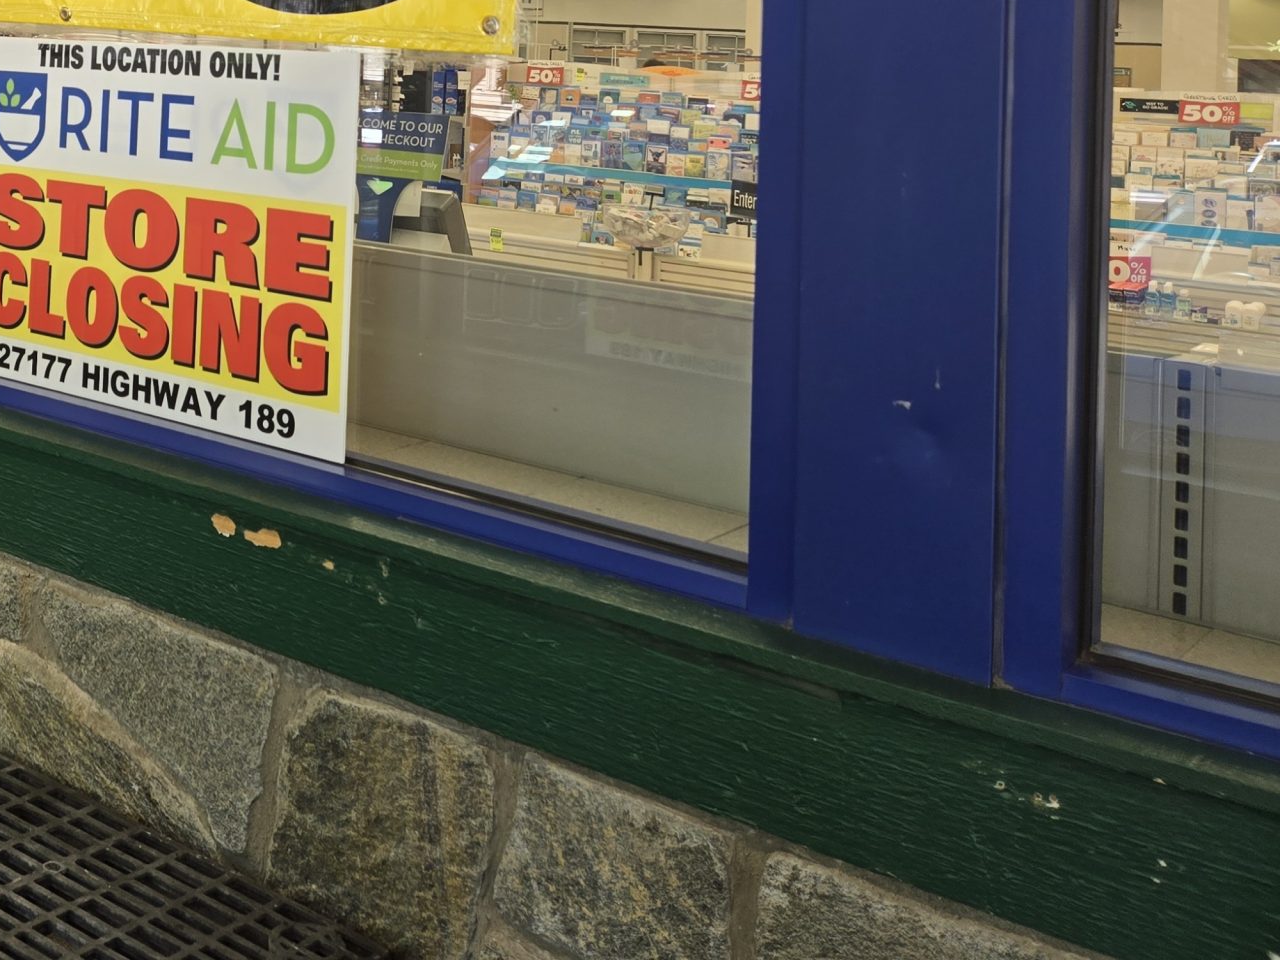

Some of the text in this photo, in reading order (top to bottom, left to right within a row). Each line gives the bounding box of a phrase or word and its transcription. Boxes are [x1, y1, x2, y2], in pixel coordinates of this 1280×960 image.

[38, 44, 281, 81] THIS LOCATION ONLY!
[1182, 104, 1235, 123] 50%
[58, 86, 336, 175] RITE AID
[357, 118, 443, 134] LCOME TO OUR
[381, 133, 436, 147] HECKOUT
[384, 156, 419, 167] Payments
[420, 161, 438, 169] Only
[1130, 274, 1147, 283] OFF
[82, 362, 225, 422] HIGHWAY
[238, 400, 295, 439] 189
